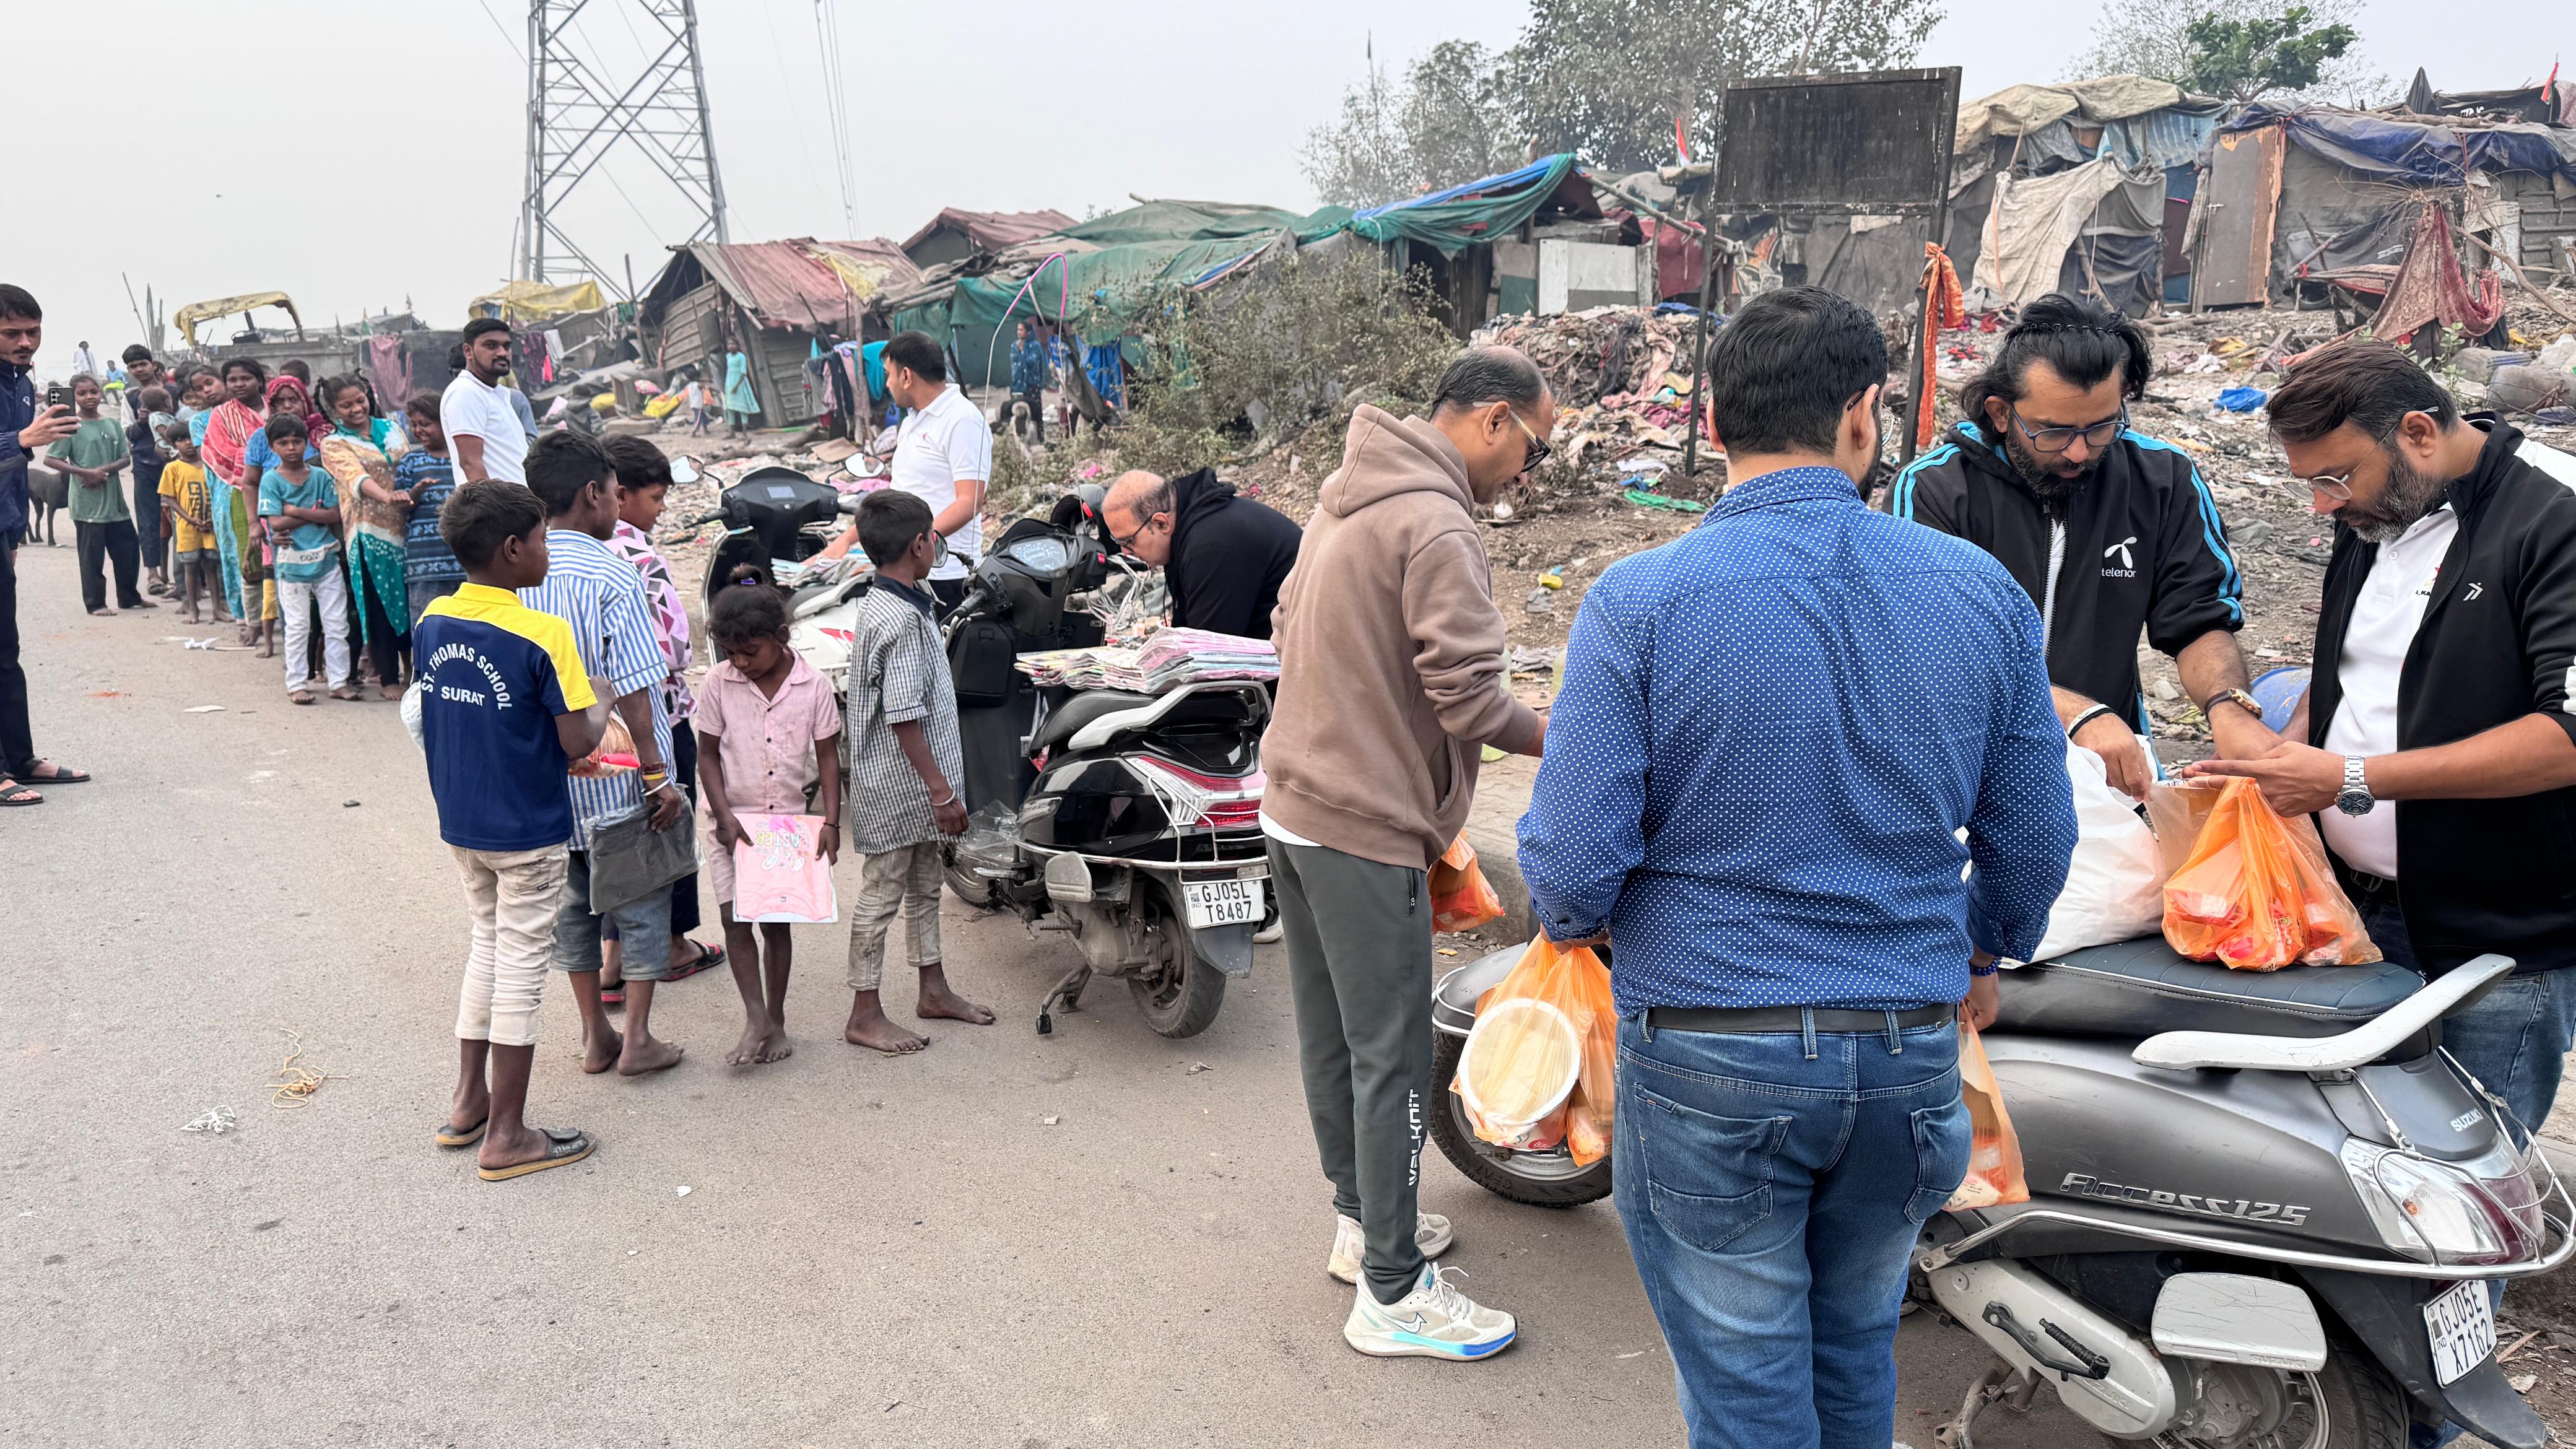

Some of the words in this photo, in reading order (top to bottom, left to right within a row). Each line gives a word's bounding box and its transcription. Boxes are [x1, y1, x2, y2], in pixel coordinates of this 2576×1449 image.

[2101, 567, 2136, 578] telenor
[421, 672, 435, 693] ST.
[429, 643, 475, 671] THOMAS
[476, 655, 513, 710] SCHOOL
[440, 685, 485, 707] SURAT
[755, 830, 809, 849] EASTER
[1202, 882, 1250, 903] GJ05L
[1205, 900, 1251, 923] T8487
[2450, 1108, 2484, 1132] SUZUKI
[2439, 1280, 2482, 1335] GJ05E
[2436, 1337, 2447, 1351] IND
[2450, 1318, 2492, 1375] X7162
[2249, 1354, 2307, 1368] SUZUKI
